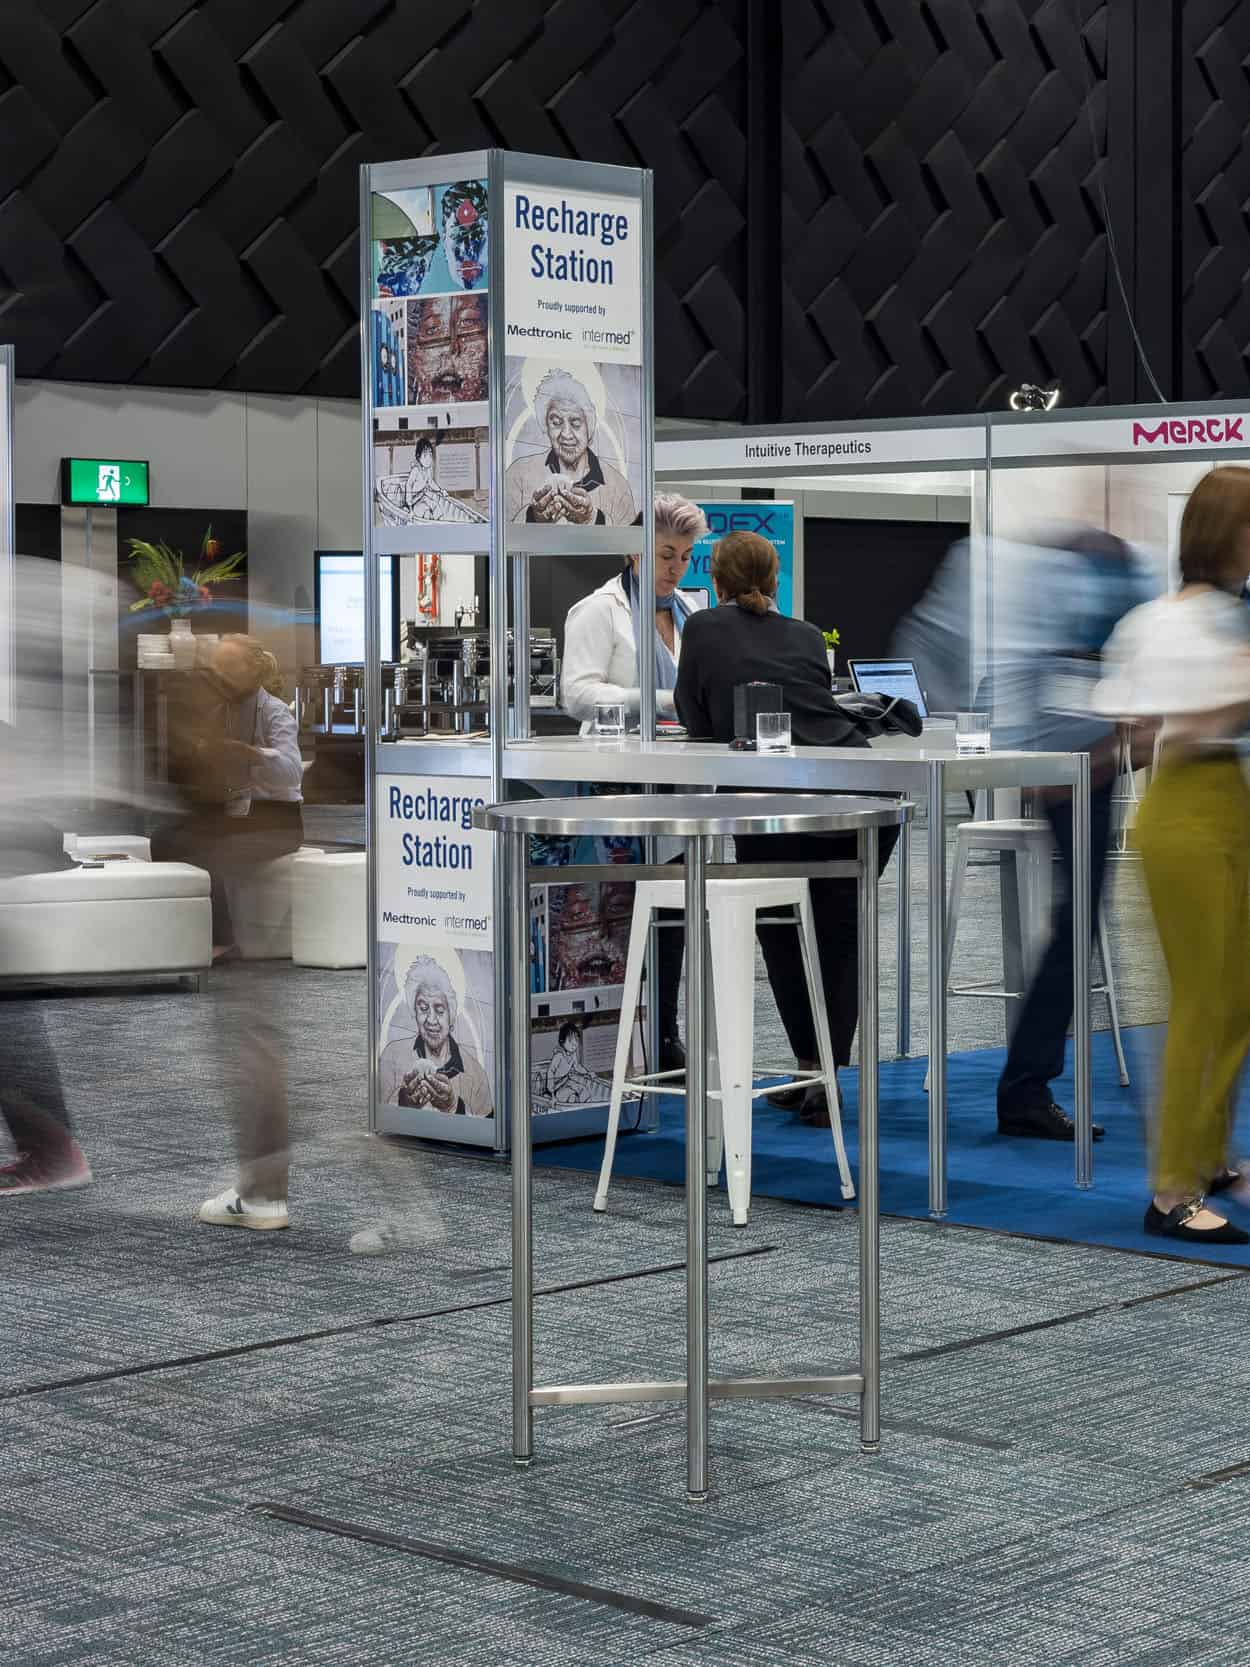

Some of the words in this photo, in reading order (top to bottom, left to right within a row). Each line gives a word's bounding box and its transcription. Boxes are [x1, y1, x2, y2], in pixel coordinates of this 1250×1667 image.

[515, 194, 628, 246] Recharge
[530, 243, 613, 285] Station
[537, 299, 562, 312] Proudly
[564, 303, 597, 314] supported
[598, 305, 606, 316] by
[507, 324, 573, 340] Medtronic
[745, 443, 791, 458] Intuitive
[794, 440, 872, 458] Therapeutics
[402, 832, 473, 870] Station
[407, 886, 429, 899] Proudly
[430, 889, 458, 901] supported
[458, 891, 466, 903] by
[382, 911, 438, 927] Medtronic
